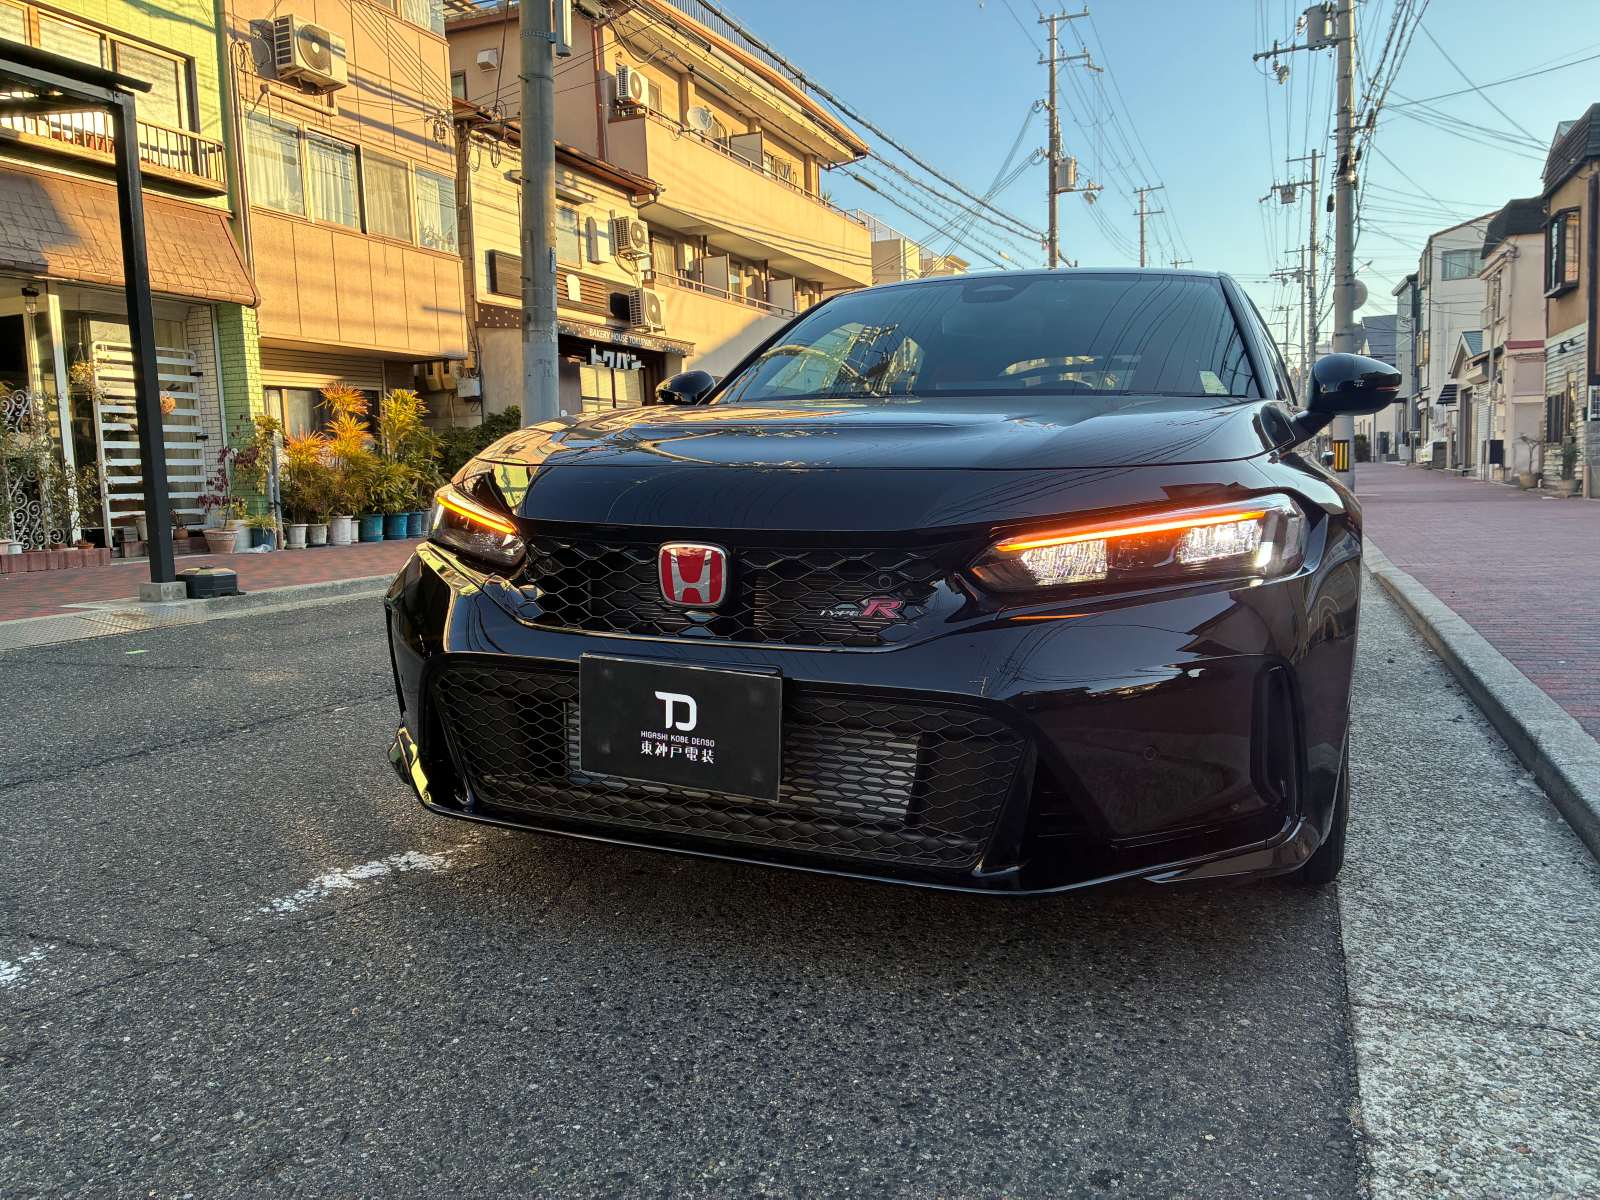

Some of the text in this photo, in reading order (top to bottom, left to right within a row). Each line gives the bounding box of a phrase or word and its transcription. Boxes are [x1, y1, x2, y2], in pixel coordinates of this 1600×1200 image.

[589, 328, 610, 339] BAKERY
[611, 332, 629, 343] HOUSE
[861, 596, 903, 619] R
[640, 730, 668, 741] HIGASHI
[670, 734, 690, 744] KOBE
[640, 740, 714, 764] 東神戸電装
